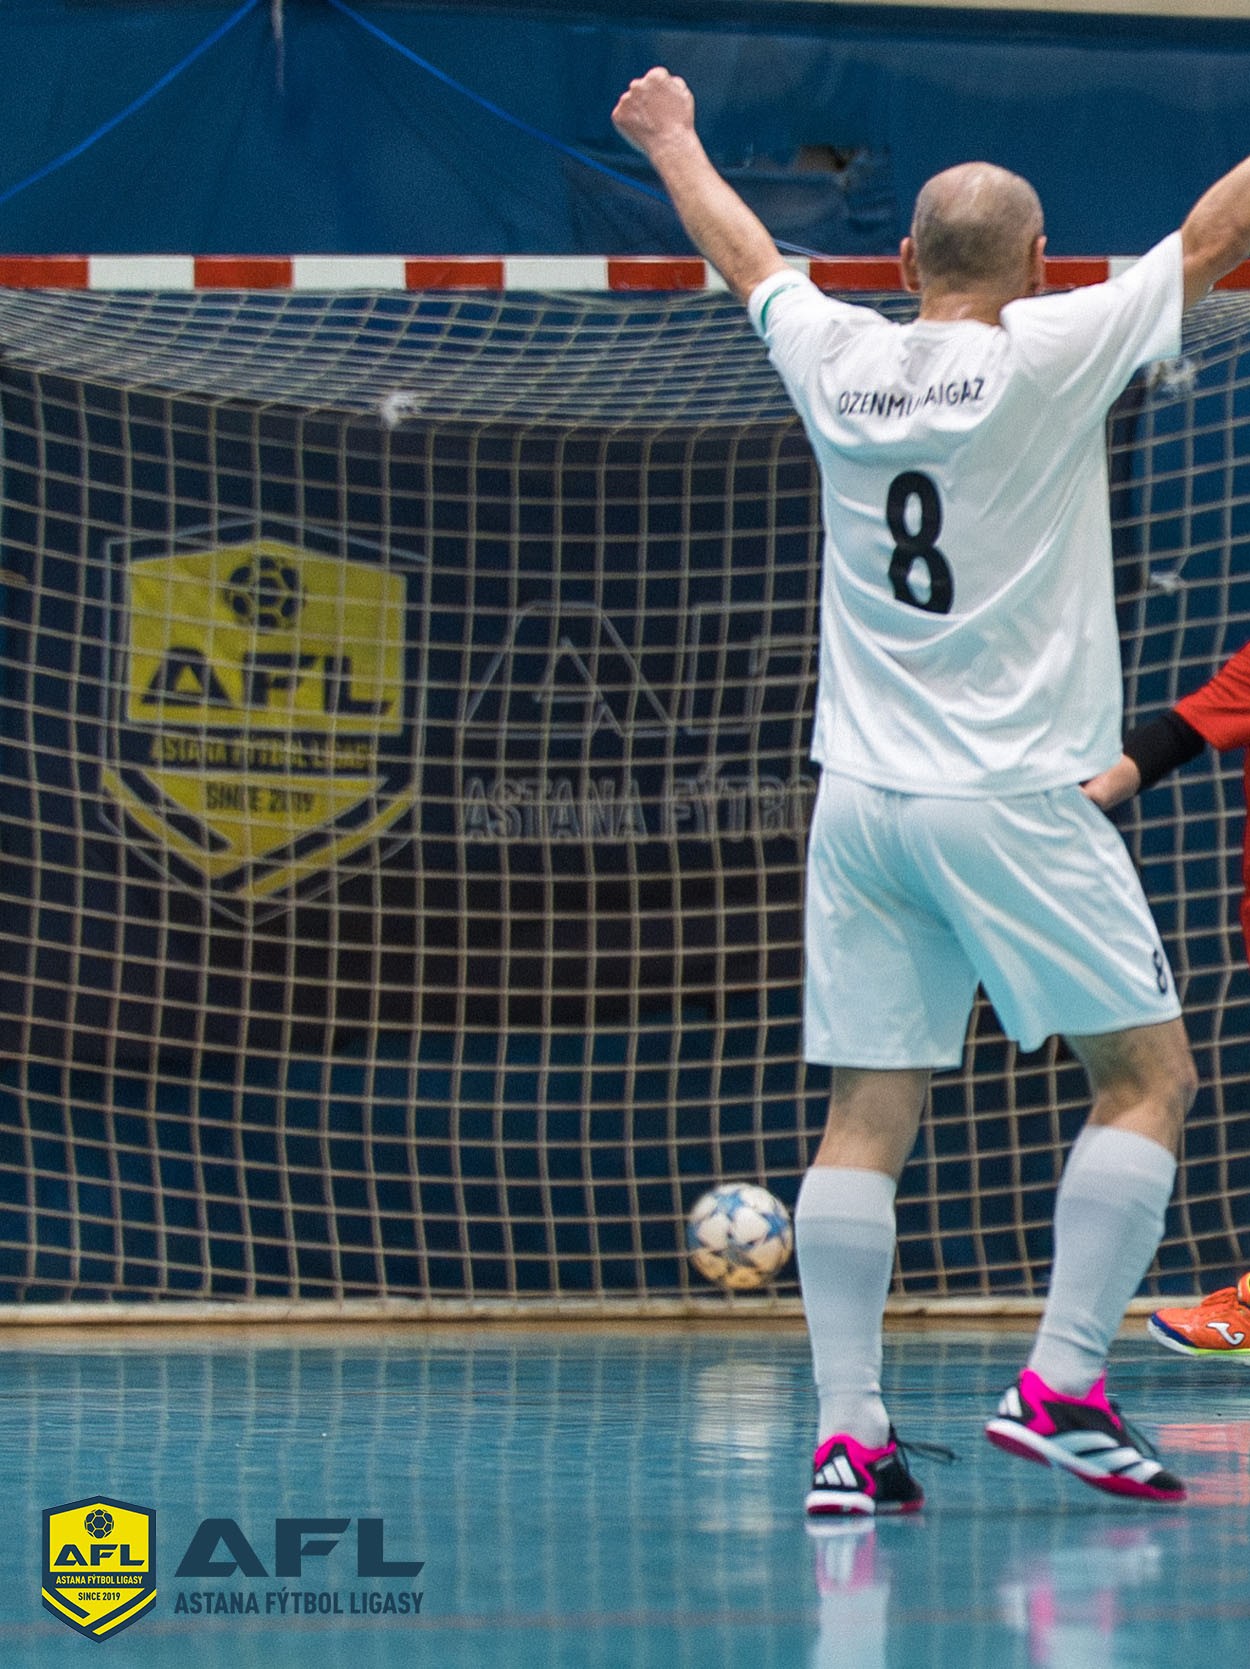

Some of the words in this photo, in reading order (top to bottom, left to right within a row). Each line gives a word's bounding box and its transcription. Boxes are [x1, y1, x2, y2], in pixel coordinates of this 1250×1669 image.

[838, 376, 986, 419] OZENMUAIGAZ
[886, 469, 955, 615] 8
[141, 646, 394, 715] AFL
[463, 776, 648, 842] ASTANA
